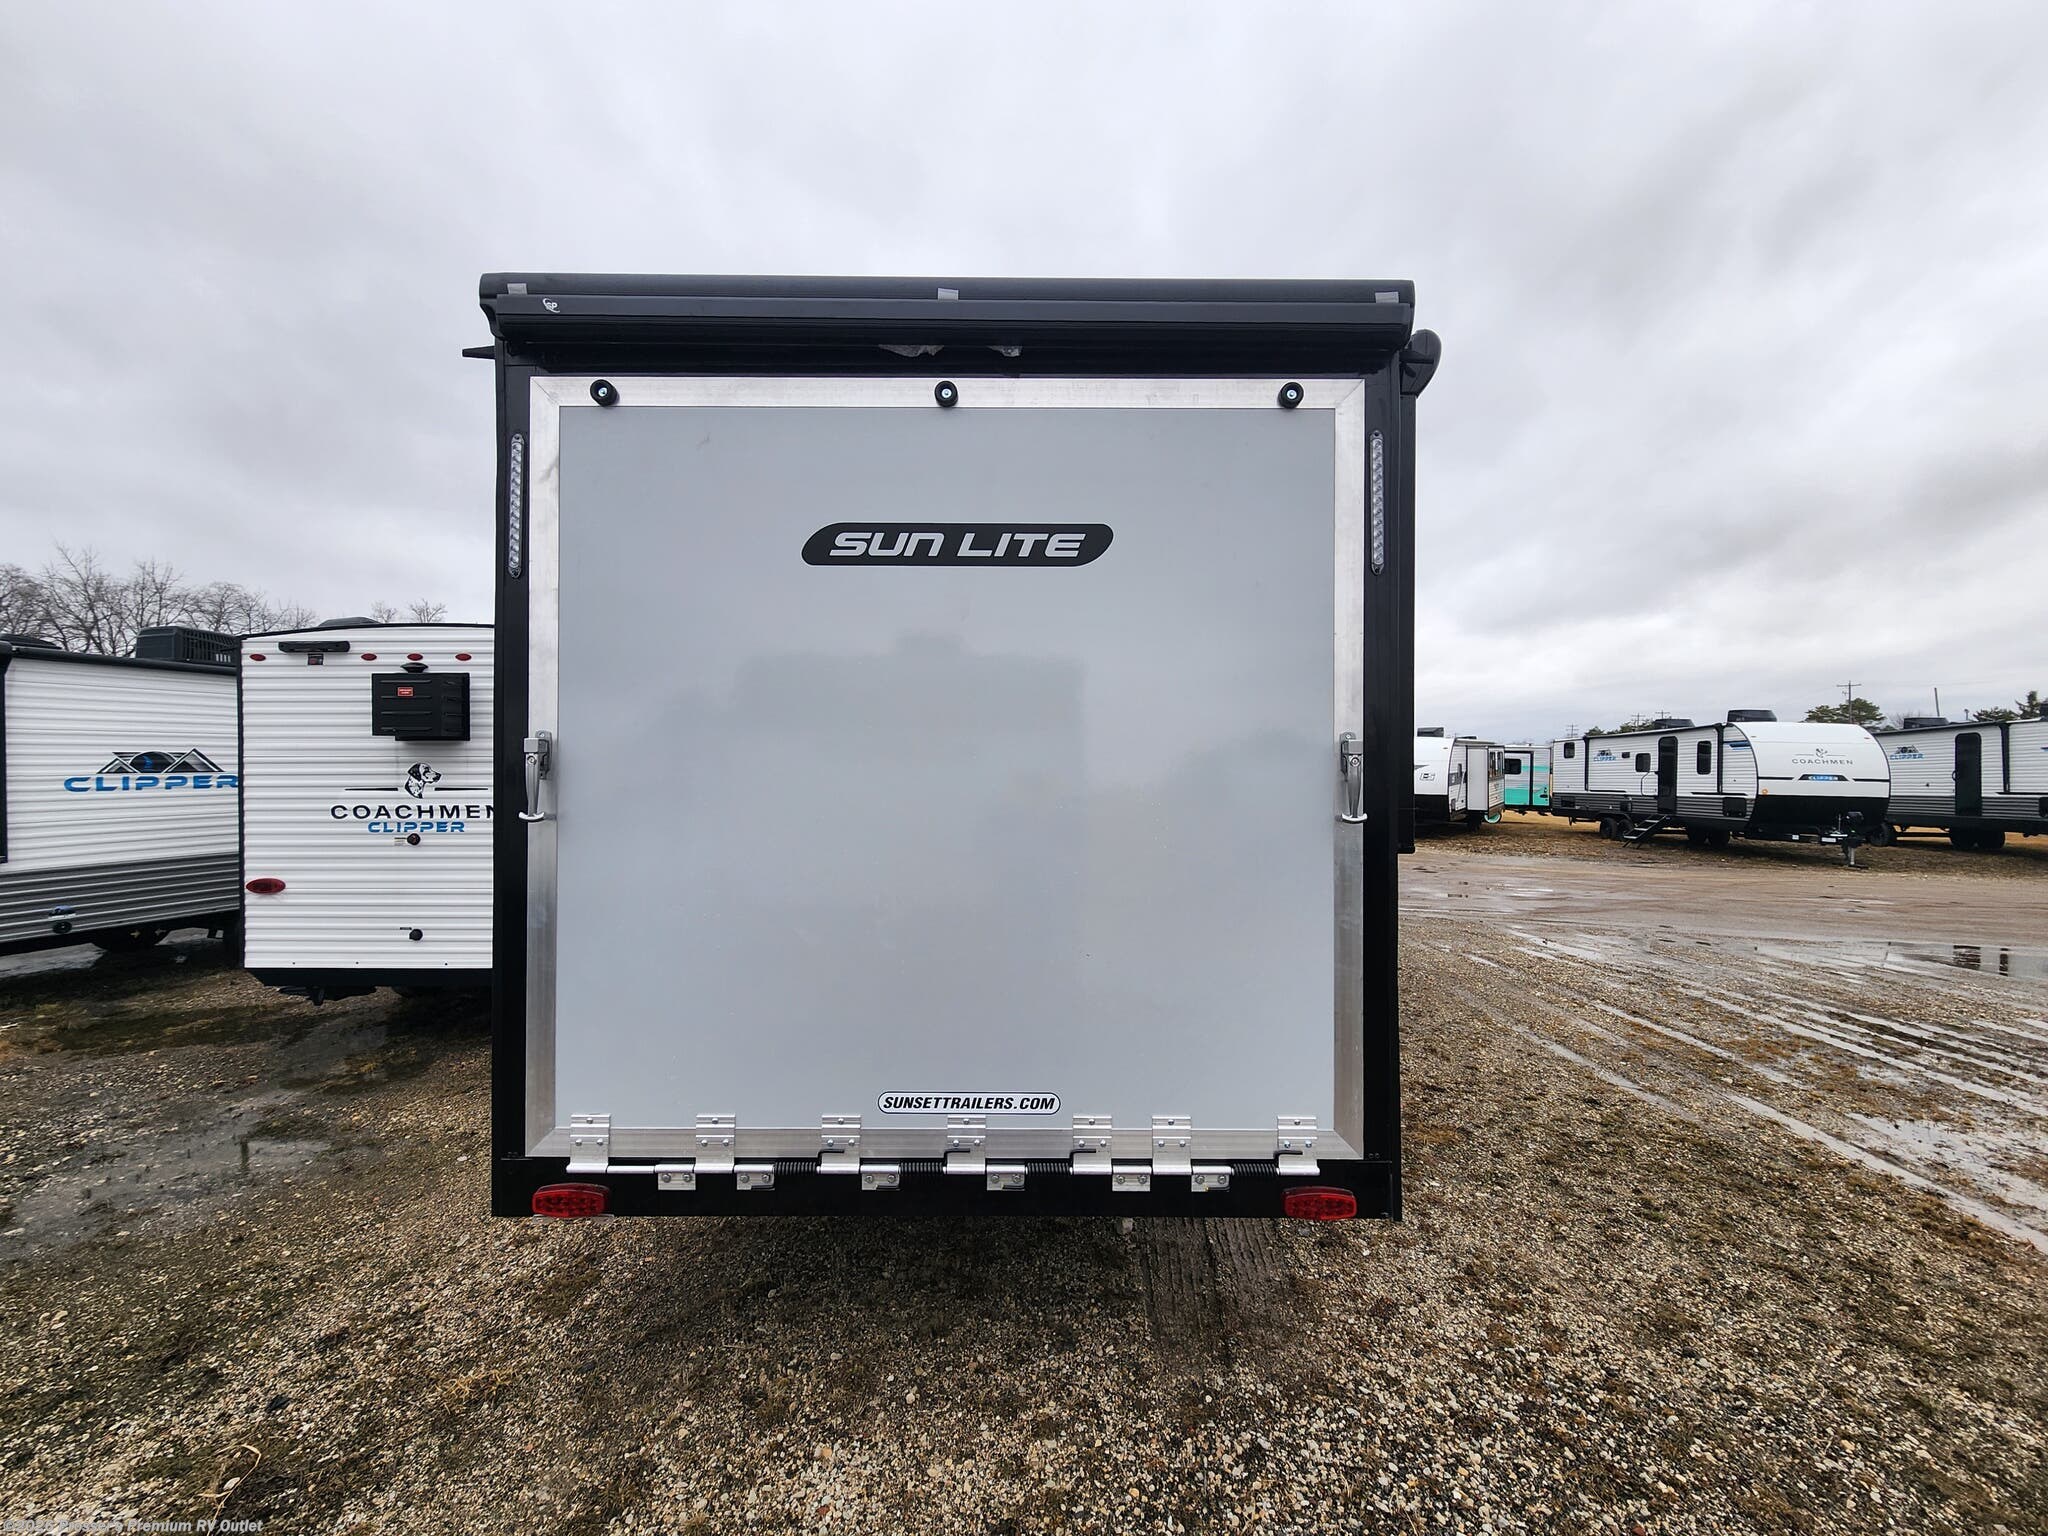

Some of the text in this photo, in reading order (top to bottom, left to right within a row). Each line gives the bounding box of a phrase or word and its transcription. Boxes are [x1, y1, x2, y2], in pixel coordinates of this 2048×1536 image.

[829, 531, 1087, 558] SUN LITE
[63, 774, 239, 793] CLIPPER
[367, 821, 465, 833] CLIPPER
[883, 1096, 1056, 1110] SUNSETTRAILERS.COM
